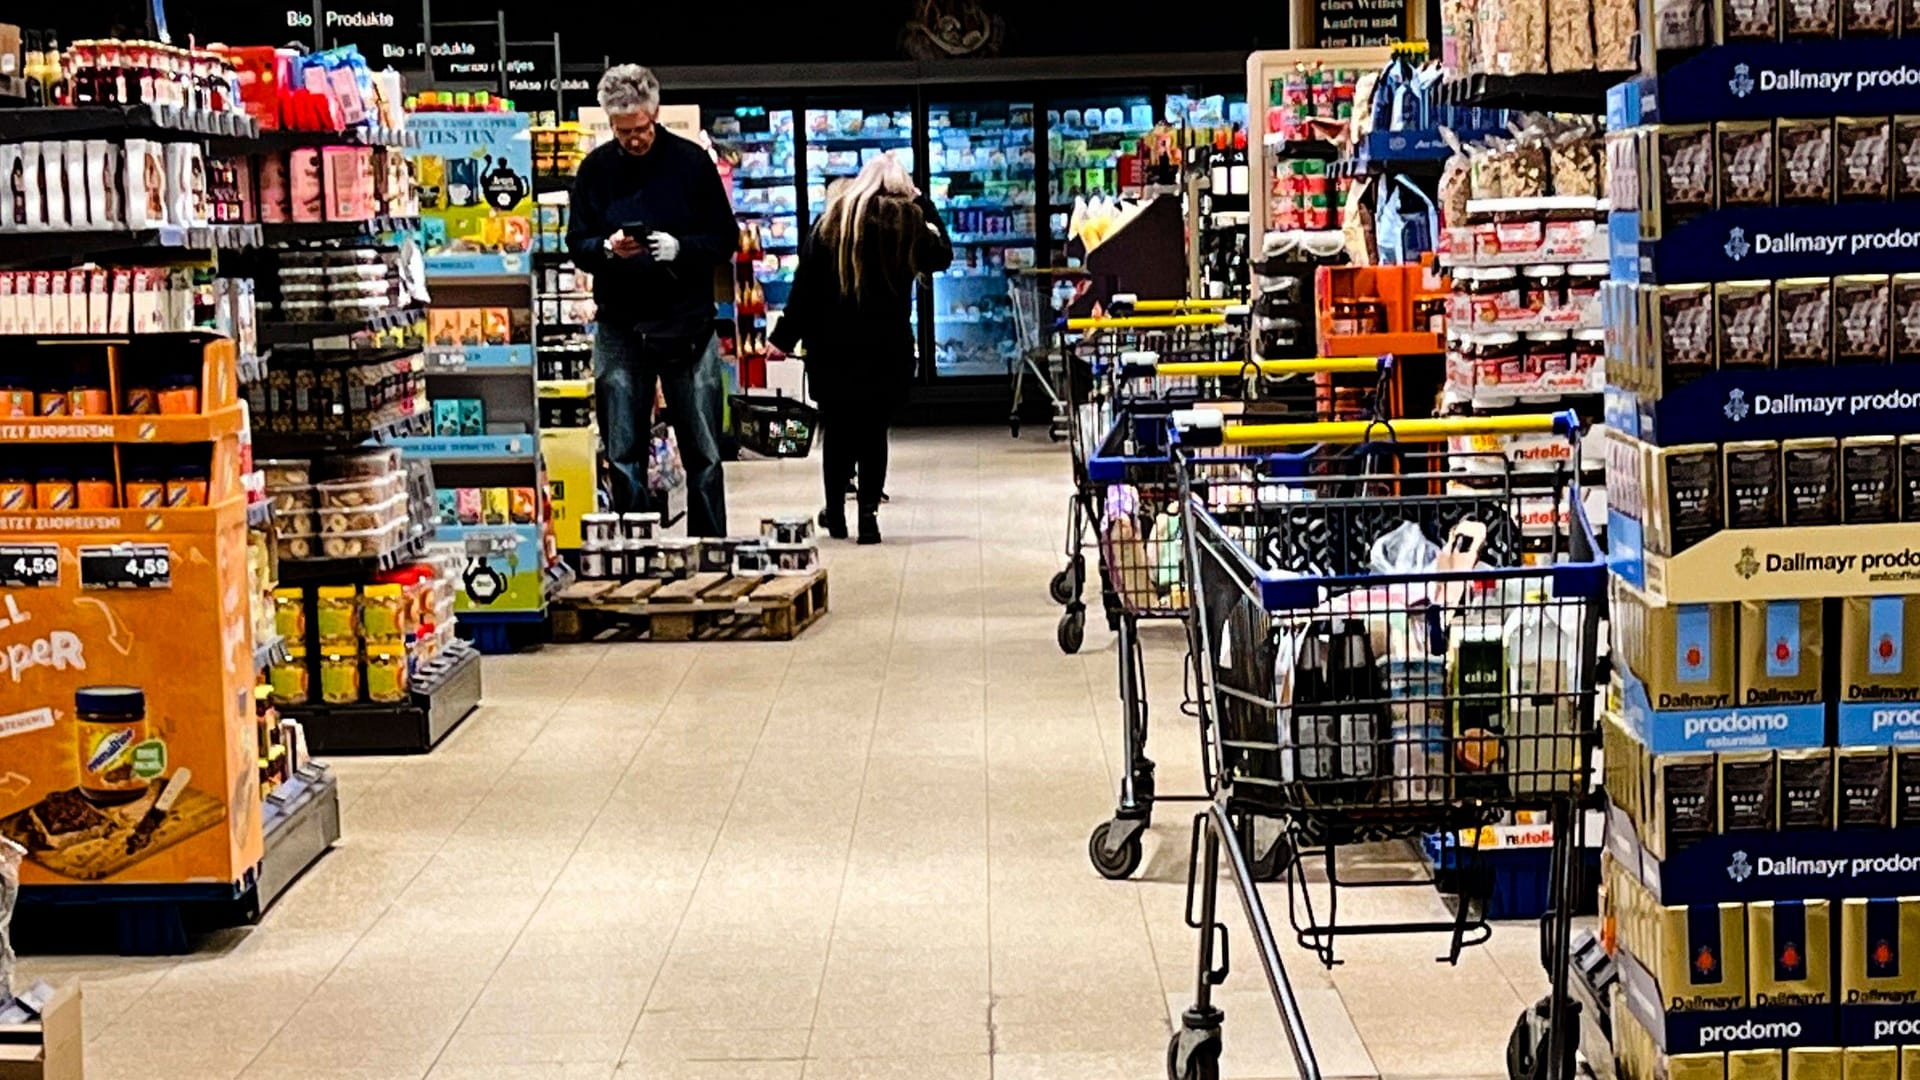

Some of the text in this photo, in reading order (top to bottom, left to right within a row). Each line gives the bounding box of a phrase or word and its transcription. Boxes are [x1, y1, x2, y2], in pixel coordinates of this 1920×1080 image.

[286, 10, 394, 27] Bio Produkte
[1323, 14, 1398, 29] kaufen und
[382, 43, 405, 58] Bio
[416, 42, 475, 57] Podukte
[1760, 65, 1920, 93] Dallmayr prodo
[1755, 232, 1848, 256] Dallmayr
[1754, 393, 1847, 417] Dallmayr
[1513, 443, 1571, 460] nutella
[13, 556, 58, 577] 4,59
[125, 557, 170, 579] 4,59
[1766, 552, 1858, 574] Dallmayr
[1659, 693, 1730, 709] Dallmayr
[1747, 687, 1817, 704] Dallmayr
[1848, 684, 1919, 700] Dallmayr
[1684, 711, 1789, 740] prodomo
[1505, 830, 1553, 846] nutell
[1757, 856, 1849, 879] Dallmayr
[1699, 1019, 1802, 1047] prodomo
